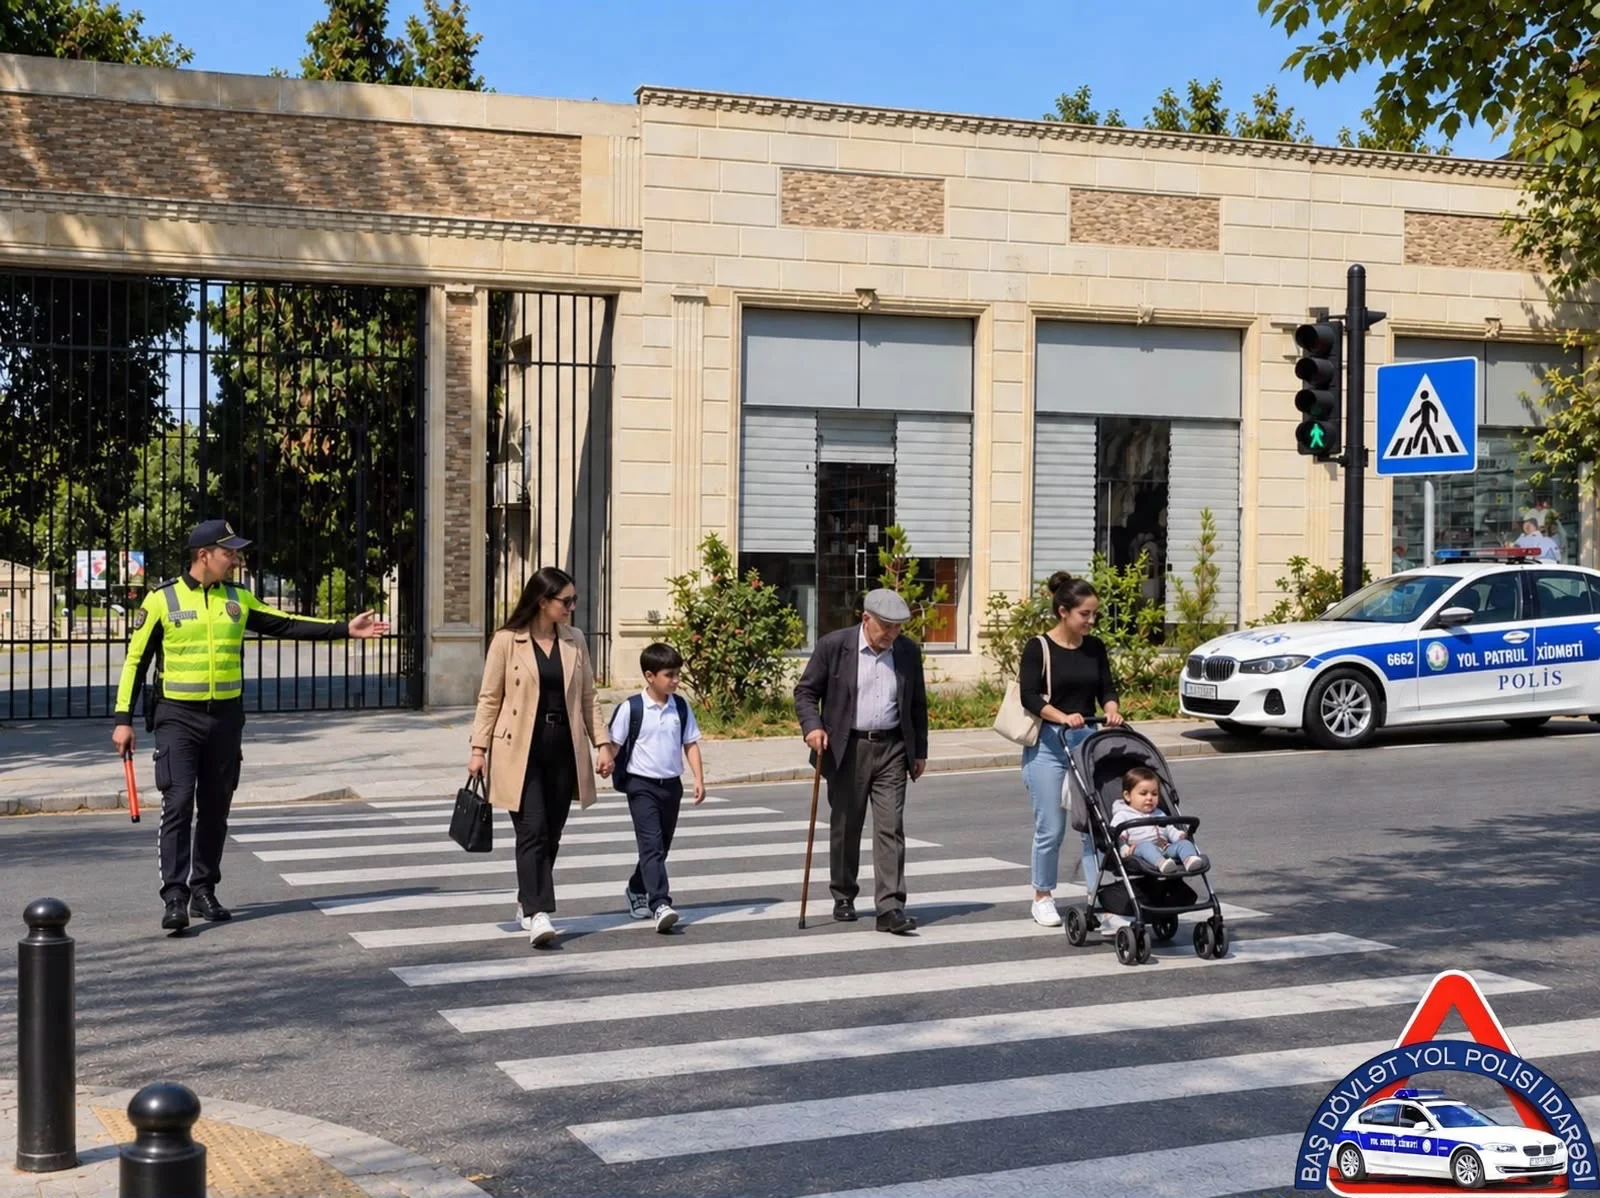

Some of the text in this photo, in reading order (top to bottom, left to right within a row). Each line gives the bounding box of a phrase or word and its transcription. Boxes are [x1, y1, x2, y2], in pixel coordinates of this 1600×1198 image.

[1387, 652, 1414, 666] 6662
[1457, 652, 1480, 668] YOL
[1484, 648, 1528, 665] PATRUL
[1499, 668, 1562, 690] POLİS
